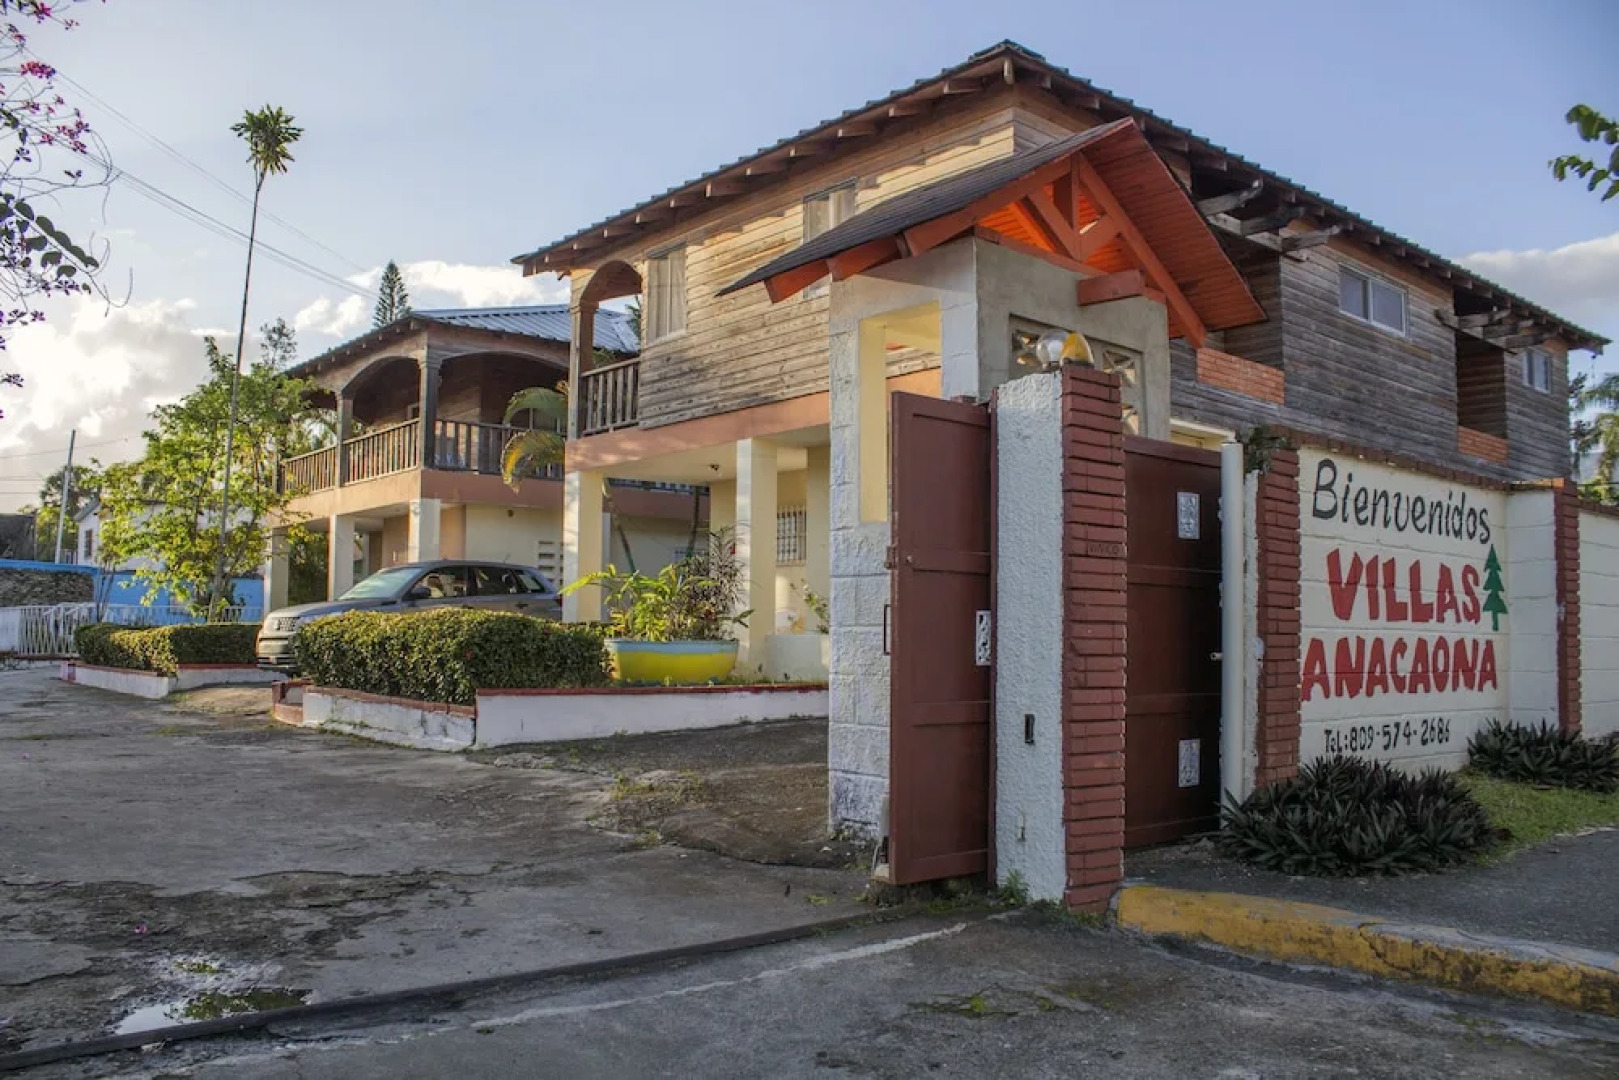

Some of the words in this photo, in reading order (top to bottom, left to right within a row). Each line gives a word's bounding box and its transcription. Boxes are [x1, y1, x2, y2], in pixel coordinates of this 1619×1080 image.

[1312, 458, 1490, 544] Bienvenidos
[1326, 548, 1480, 625] VILLAS
[1301, 635, 1497, 701] ANACAONA
